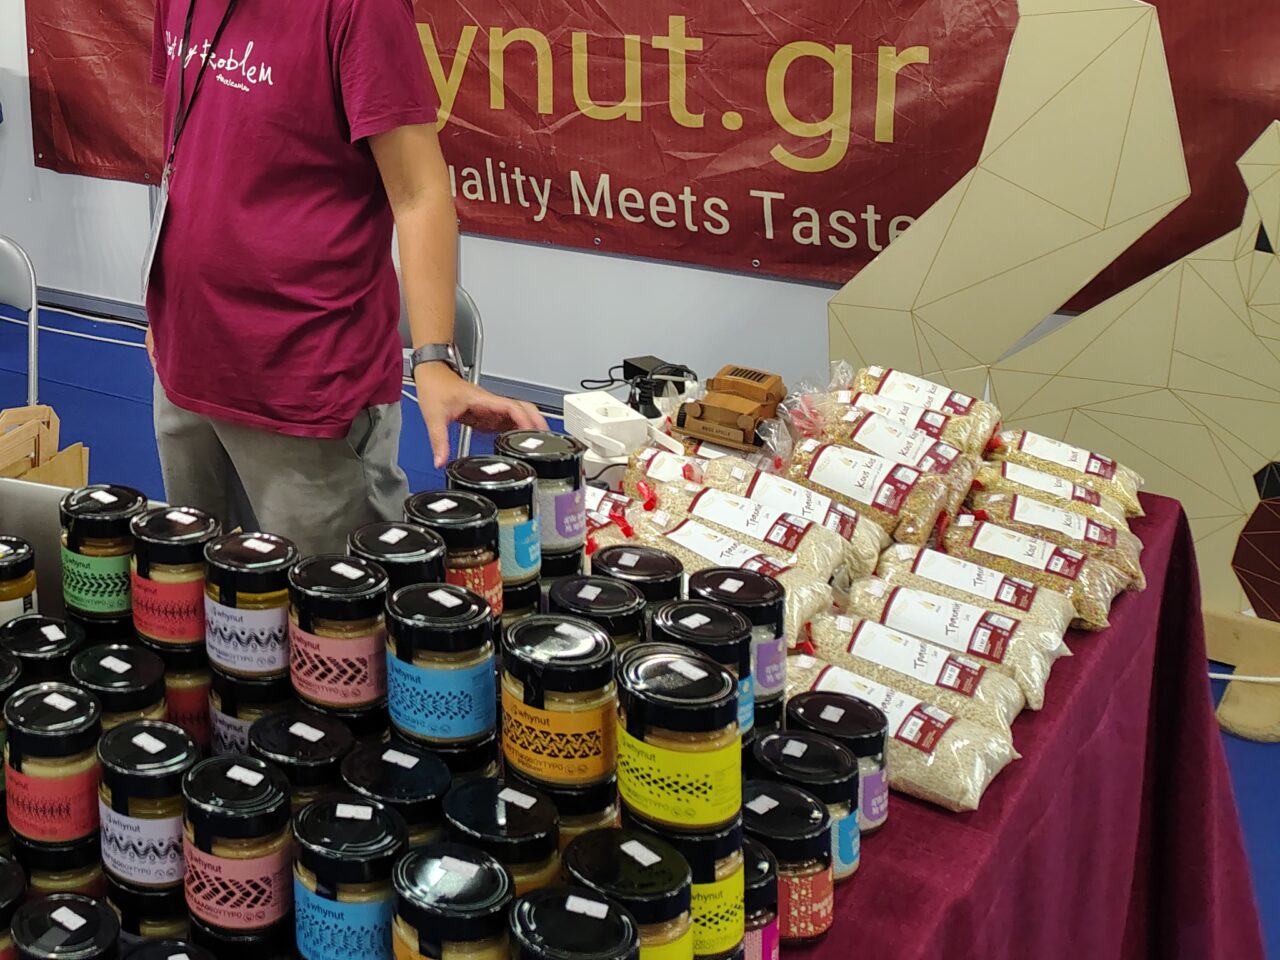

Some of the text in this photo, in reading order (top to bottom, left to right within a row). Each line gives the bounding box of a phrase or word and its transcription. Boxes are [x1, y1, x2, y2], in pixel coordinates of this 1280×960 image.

[416, 15, 930, 173] ynut.gr
[448, 157, 551, 221] ality
[570, 170, 731, 236] Meets
